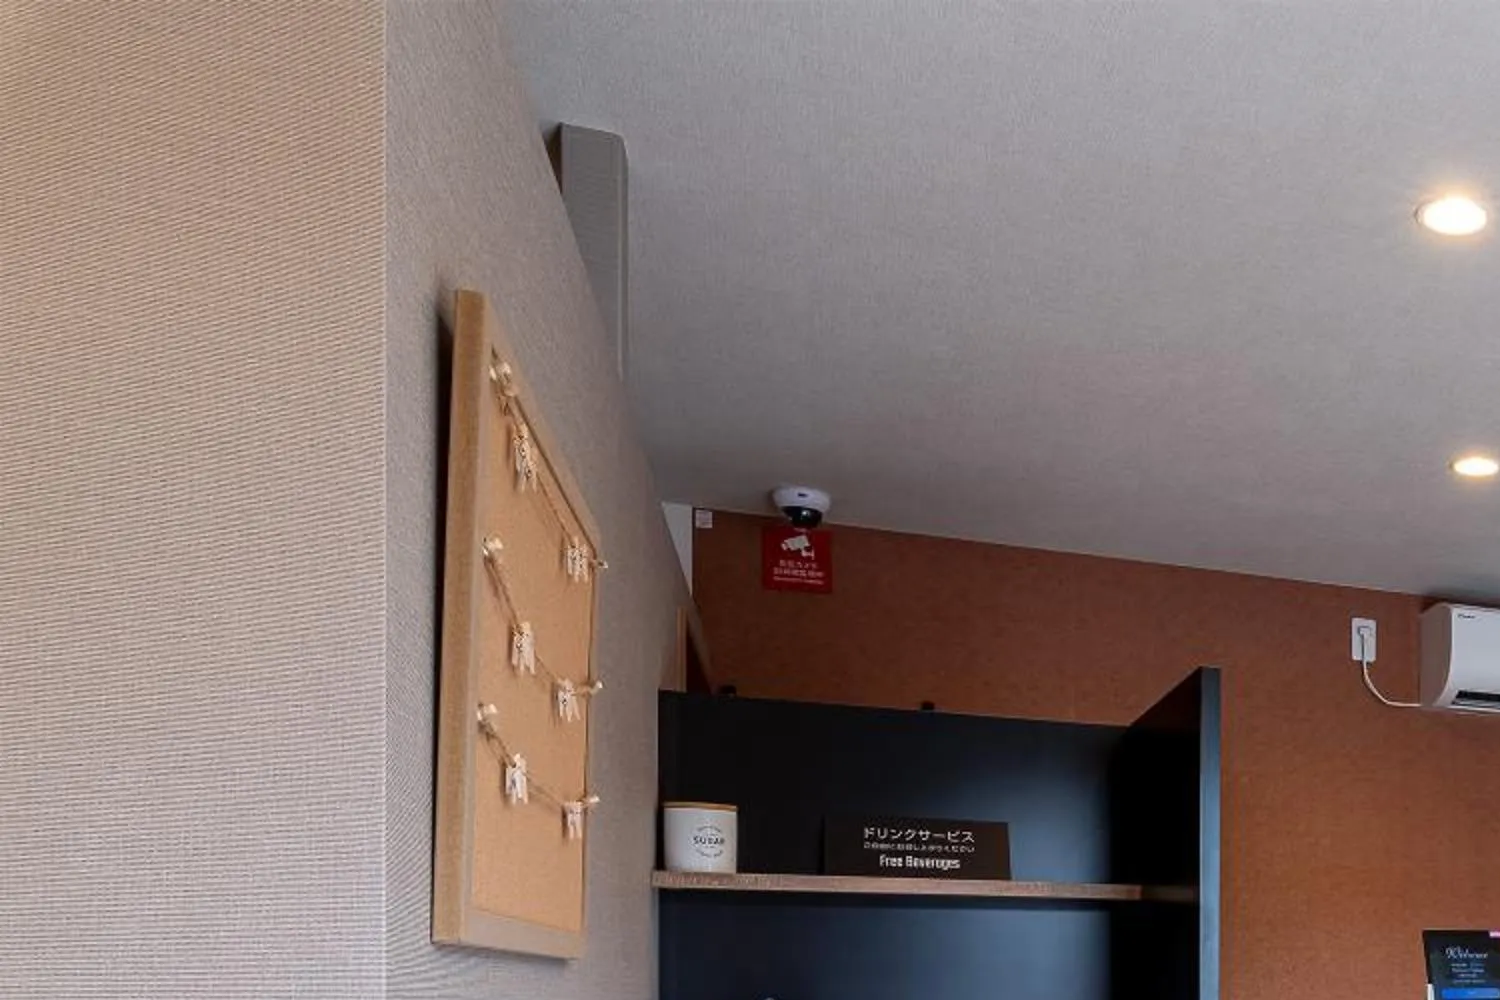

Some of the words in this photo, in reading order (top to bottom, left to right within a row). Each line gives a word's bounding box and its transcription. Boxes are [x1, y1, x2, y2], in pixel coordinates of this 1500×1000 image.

[863, 827, 975, 843] ドリンクサービス
[879, 854, 903, 868] Free
[905, 855, 961, 871] Beverages
